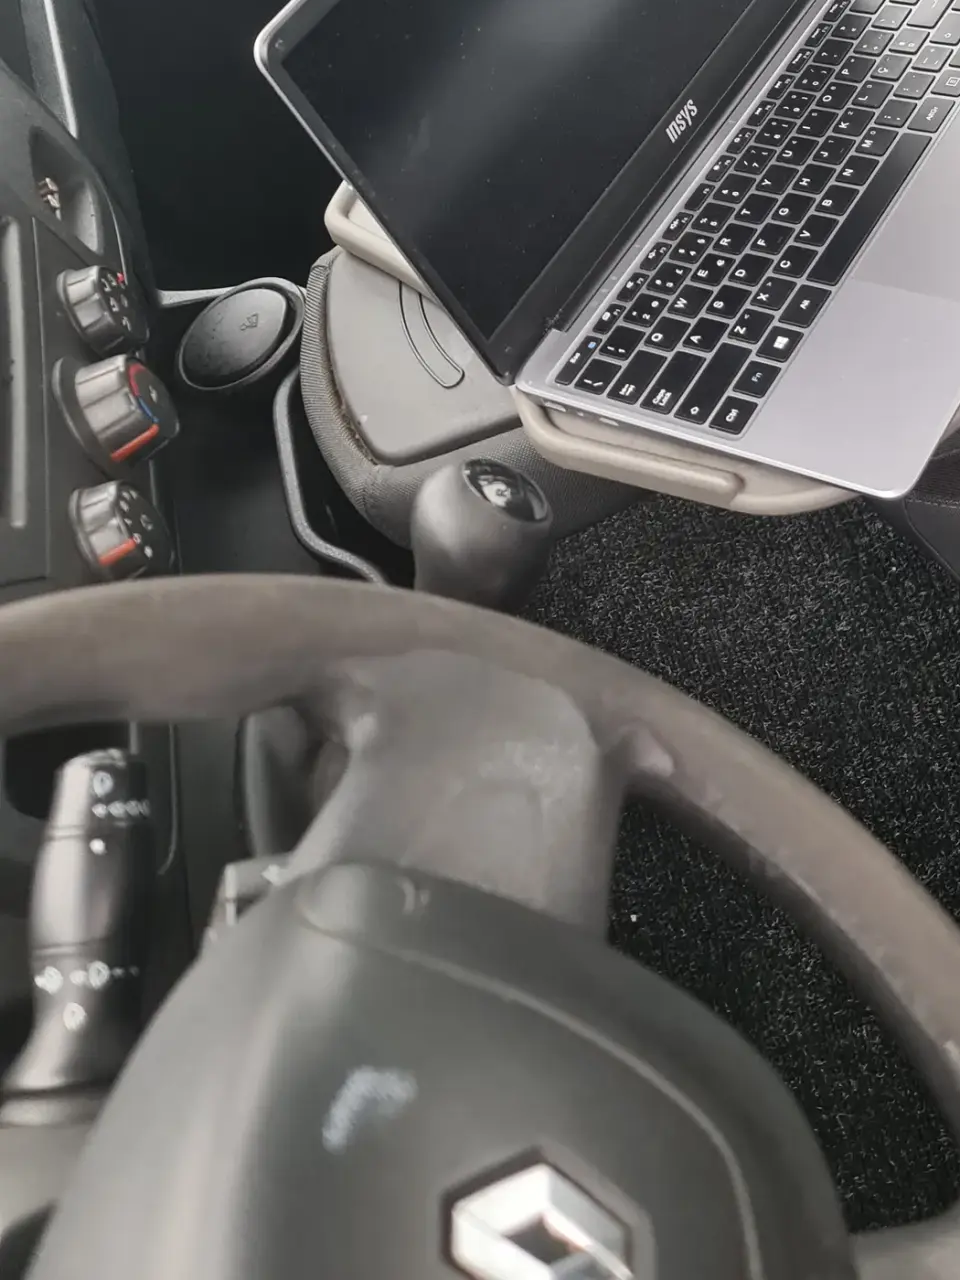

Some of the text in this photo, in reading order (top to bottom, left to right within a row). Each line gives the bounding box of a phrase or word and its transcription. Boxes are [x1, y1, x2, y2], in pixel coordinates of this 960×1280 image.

[926, 107, 938, 121] AltGr
[861, 140, 874, 148] M
[799, 178, 811, 186] H
[780, 260, 791, 268] C
[735, 269, 746, 277] D
[757, 293, 769, 301] X
[674, 297, 688, 308] W
[800, 300, 810, 310] Alt
[734, 326, 746, 334] Z
[651, 333, 663, 342] Q
[690, 335, 701, 343] A
[752, 372, 762, 382] Fn
[726, 409, 739, 422] Ctrl
